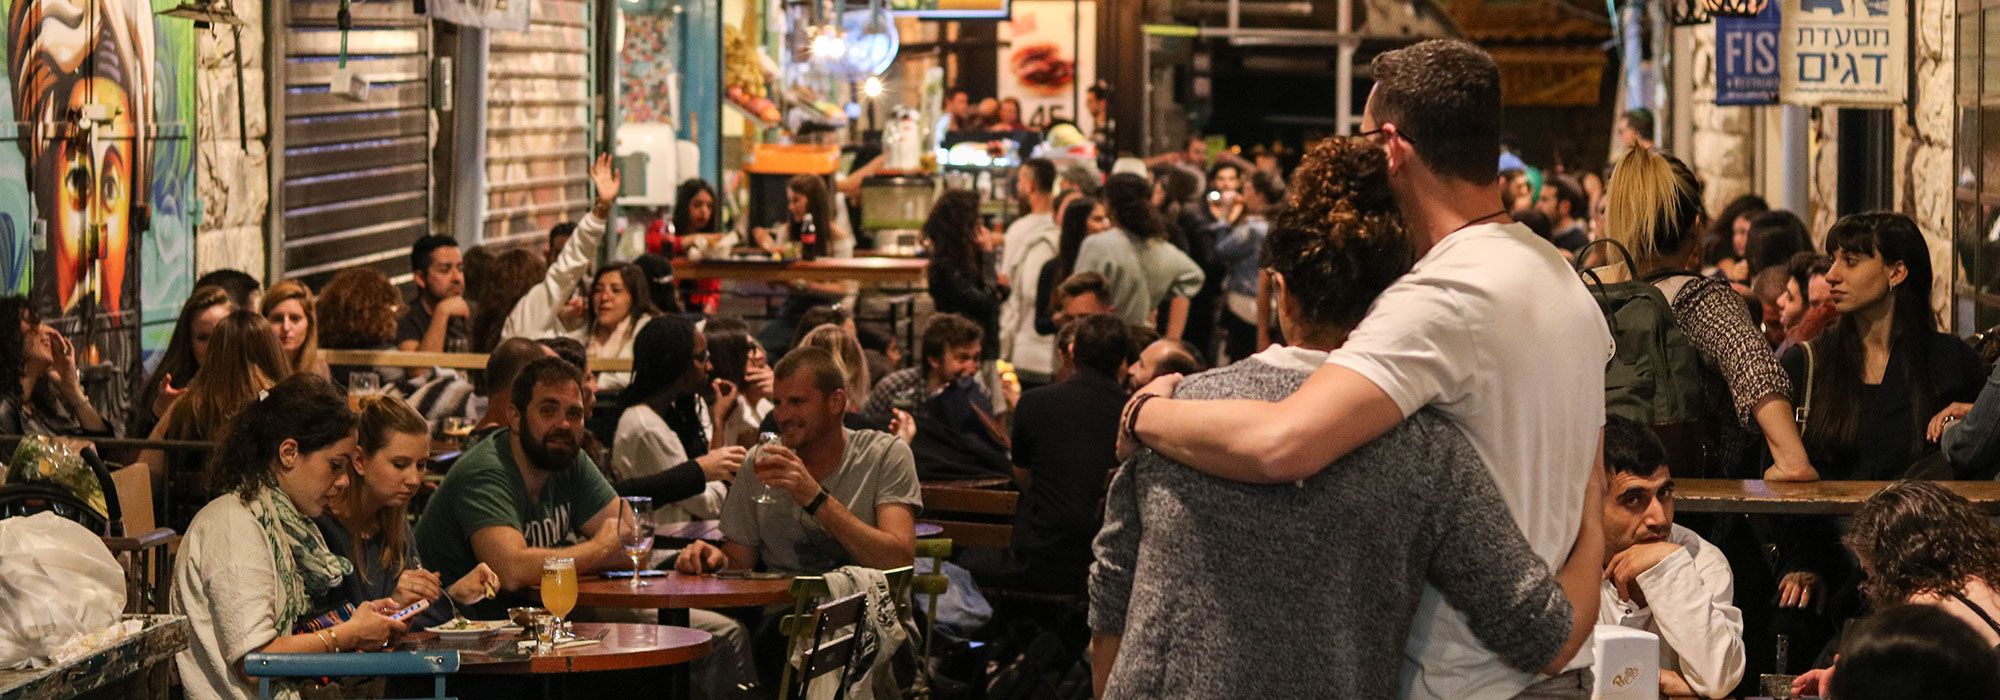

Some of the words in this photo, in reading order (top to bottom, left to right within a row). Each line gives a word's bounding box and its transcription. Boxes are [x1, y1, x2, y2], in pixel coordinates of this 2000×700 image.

[1725, 31, 1781, 74] FIS
[1796, 27, 1889, 48] מסעדת
[1796, 52, 1888, 85] דגים
